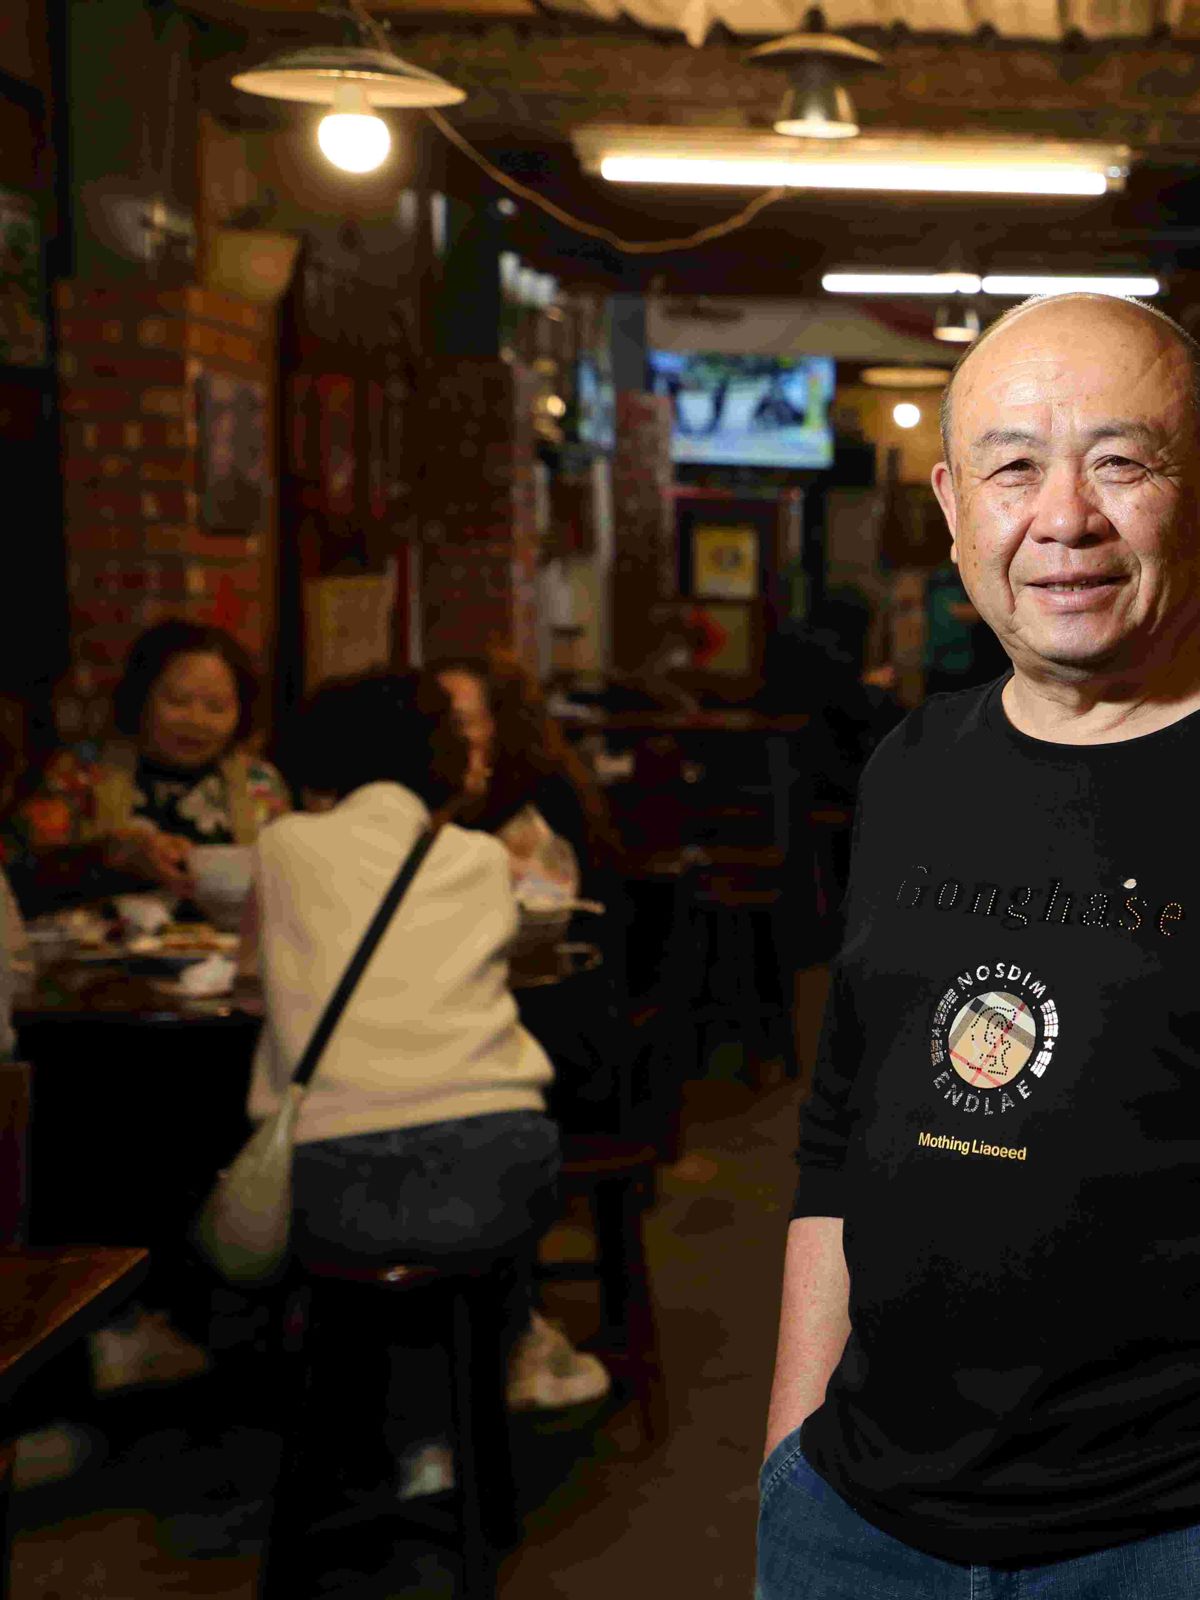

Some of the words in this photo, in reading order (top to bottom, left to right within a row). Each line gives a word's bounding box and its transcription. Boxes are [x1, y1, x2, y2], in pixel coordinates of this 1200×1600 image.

[957, 962, 1047, 999] NOSDIM
[918, 1131, 970, 1155] Mothing
[971, 1139, 1027, 1160] Liaoeed
